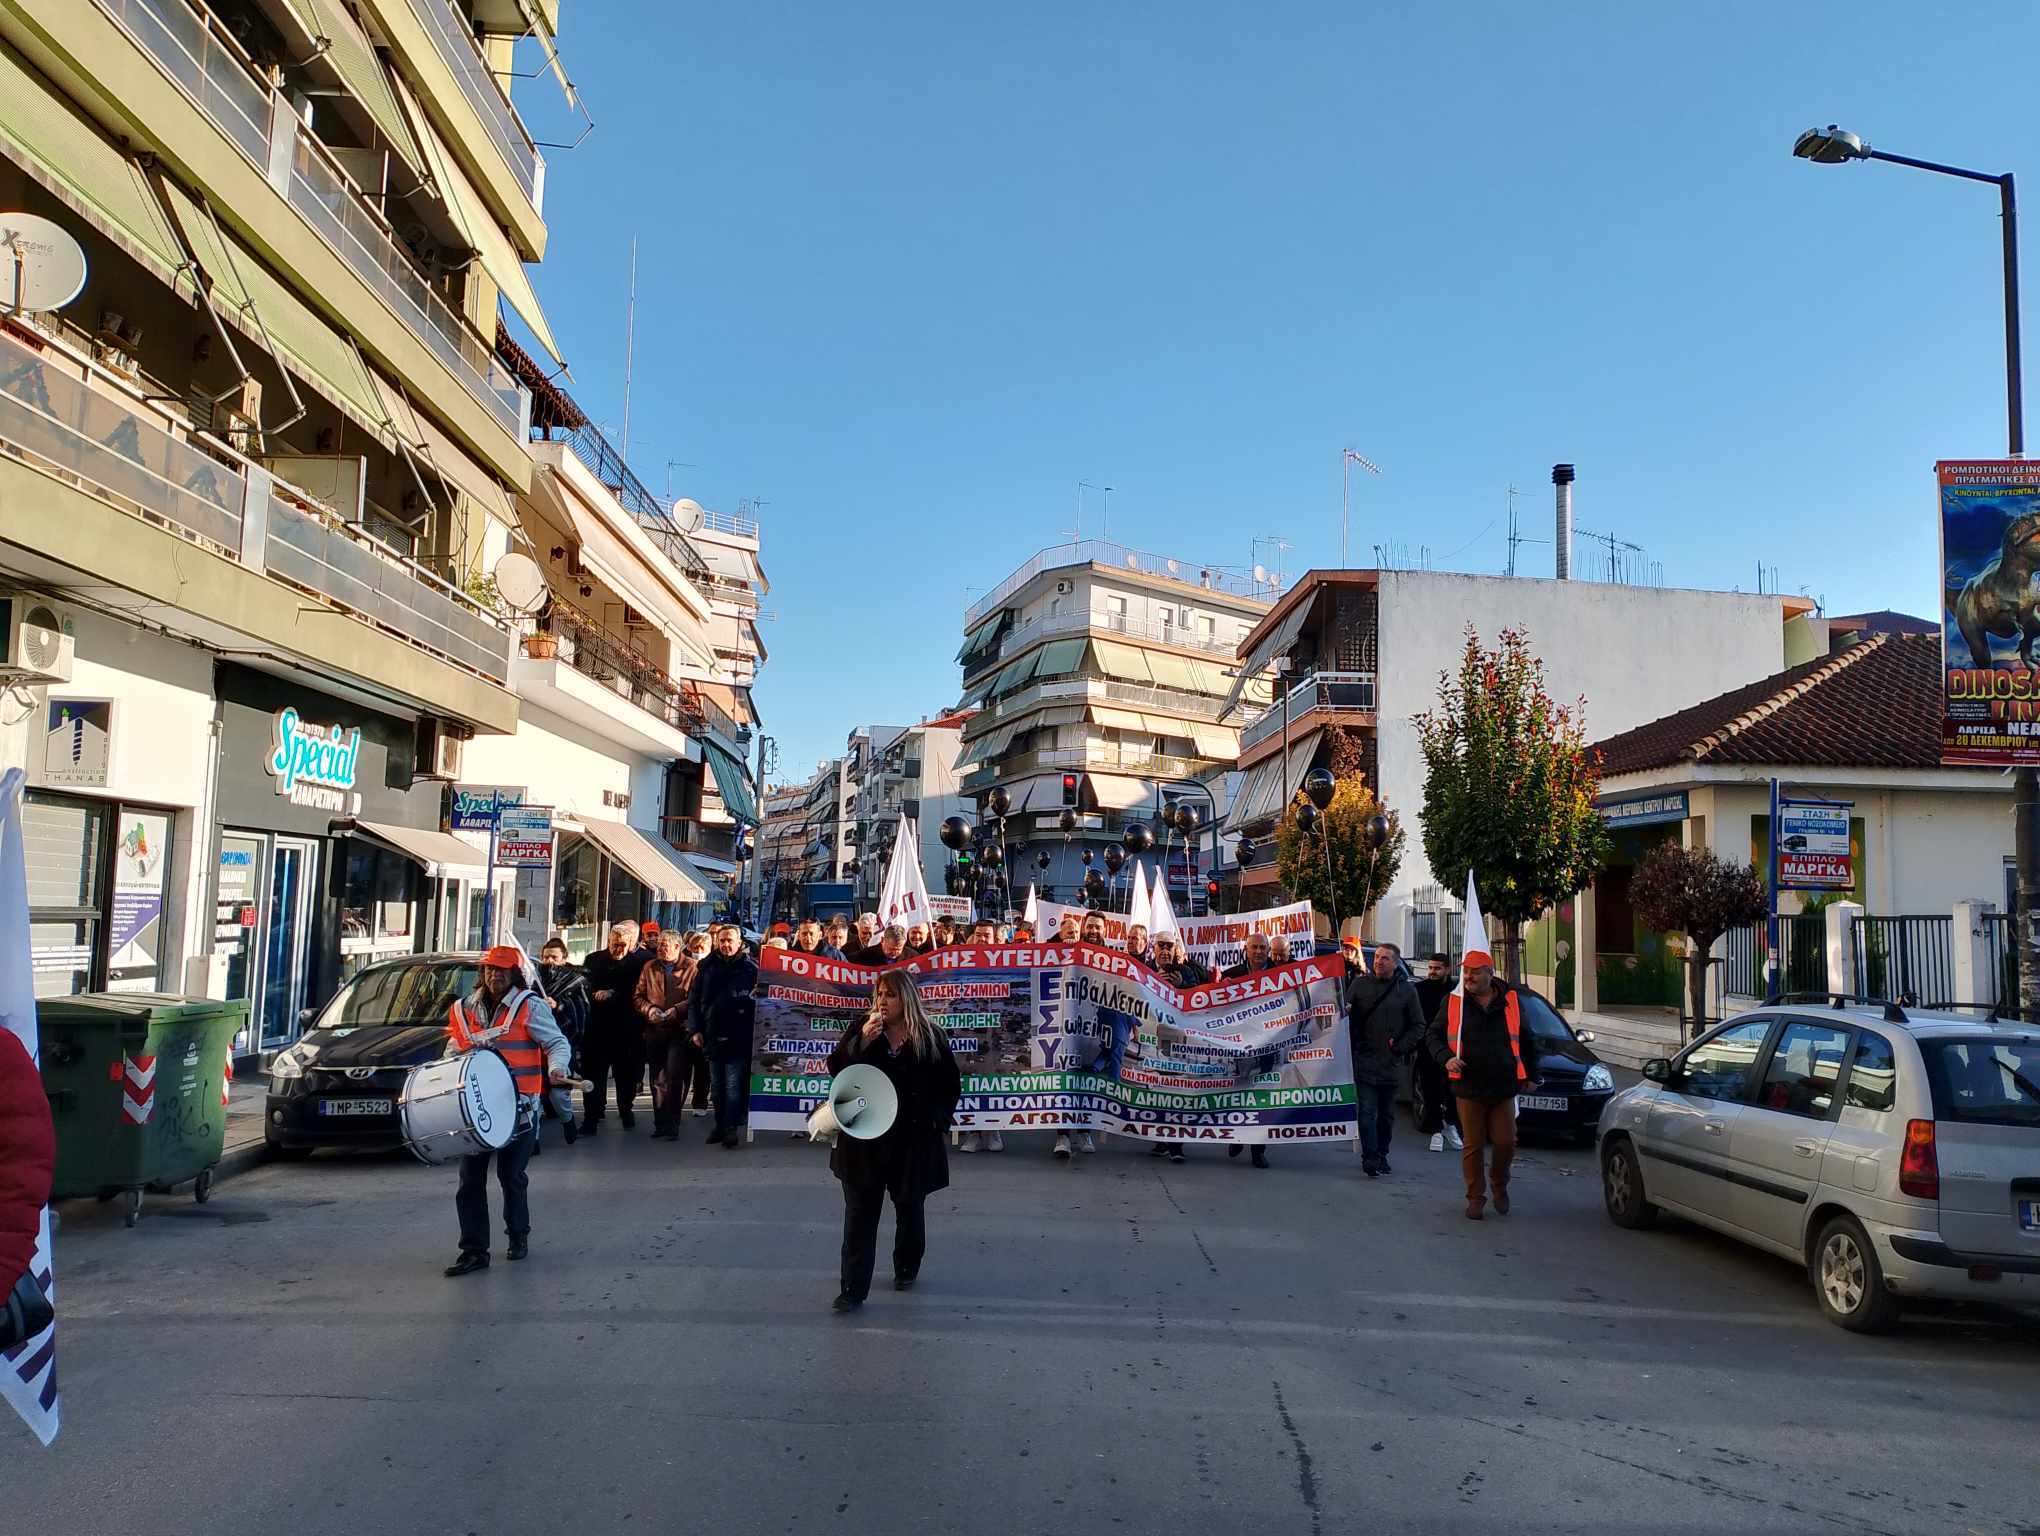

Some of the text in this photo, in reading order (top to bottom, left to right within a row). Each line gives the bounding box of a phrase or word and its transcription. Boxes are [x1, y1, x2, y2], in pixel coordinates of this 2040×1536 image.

[1945, 466, 2010, 474] ΡΟΜΠΟΤΙΚΟΙ
[1955, 476, 2024, 484] ΠΡΑΓΜΑΤΙΚΕΣ
[274, 709, 360, 790] Special
[1802, 810, 1830, 818] ΣΤΑΣΗ
[500, 849, 549, 858] ΜΑΡΓΚΑ
[1791, 855, 1837, 863] ΕΠΙΠΛΟ
[1783, 863, 1847, 876] ΜΑΡΓΚΑ
[779, 955, 809, 975] ΤΟ
[928, 948, 1324, 1010] ΤΗΣ ΥΓΕΙΑΣ ΤΩΡΑ ΣΤΗ ΘΕΣΣΑΛΙΑ
[769, 986, 871, 1009] ΚΡΑΤΙΚΗ ΜΕΡΙΜΝΑ
[961, 983, 1010, 997] ΖΗΜΙΩΝ
[1206, 997, 1286, 1030] ΕΞΩ ΟΙ ΕΡΓΟΛΑΒΟΙ
[1263, 1005, 1335, 1031] ΧΡΗΜΑΤΟΔΟΤΗΣΗ
[1140, 1034, 1157, 1045] ΒΑΕ
[1171, 1043, 1246, 1058] ΜΟΝΙΜΟΠΟΙΗΣΗ
[1288, 1049, 1333, 1061] ΚΙΝΗΤΡΑ
[1143, 1058, 1226, 1074] ΑΥΞΗΣΕΙΣ ΜΙΣΘΩΝ
[1121, 1069, 1234, 1089] ΟΧΙ ΣΤΗΝ ΙΔΙΩΤΙΚΟΠΟΙΗΣΗ
[1253, 1072, 1281, 1083] ΕΚΑΒ
[763, 1078, 830, 1094] ΣΕ ΚΑΘΕ
[969, 1075, 1061, 1092] ΠΑΛΕΥΟΥΜΕ
[1080, 1077, 1132, 1102] ΔΩΡΕΑΝ
[1136, 1095, 1209, 1110] ΔΗΜΟΣΙΑ
[1214, 1092, 1257, 1108] ΥΓΕΙΑ
[1270, 1087, 1344, 1106] ΠΡΟΝΟΙΑ
[988, 1095, 1081, 1110] ΠΟΛΙΤΩΝ
[1081, 1095, 1122, 1116] ΑΠΟ
[1127, 1108, 1157, 1121] ΤΟ
[1164, 1111, 1260, 1125] ΚΡΑΤΟΣ
[1008, 1112, 1093, 1125] ΑΓΩΝΑΣ
[1121, 1123, 1235, 1140] ΑΓΩΝΑΣ
[1267, 1125, 1348, 1139] ΠΟΕΔΗΝ
